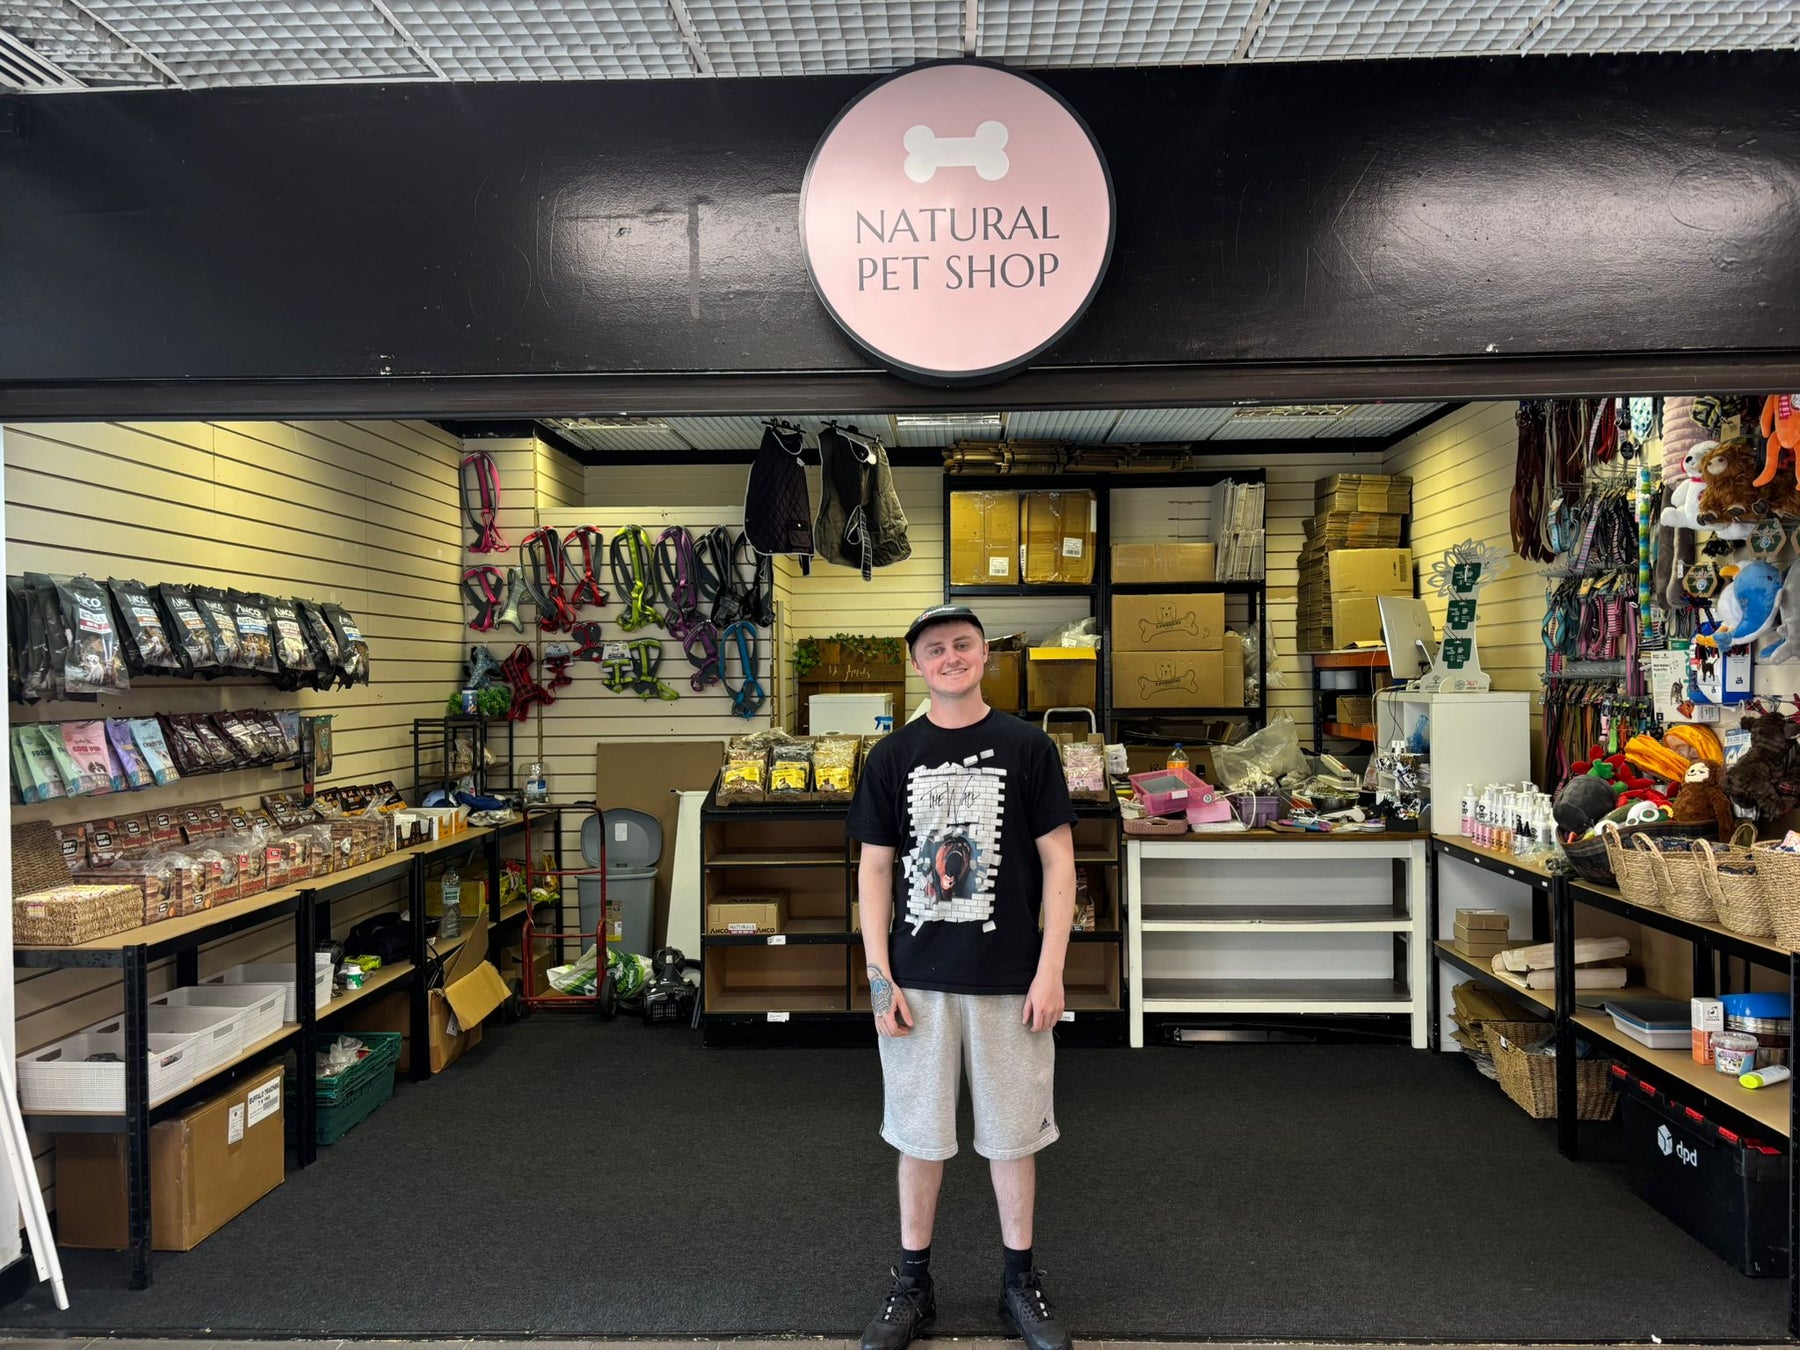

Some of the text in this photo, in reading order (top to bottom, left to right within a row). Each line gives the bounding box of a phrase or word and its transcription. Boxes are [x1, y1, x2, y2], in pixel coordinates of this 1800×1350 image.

[856, 205, 1060, 244] NATURAL
[858, 252, 1060, 291] PET SHOP
[236, 603, 261, 616] ANCO
[1676, 1140, 1698, 1168] dpd
